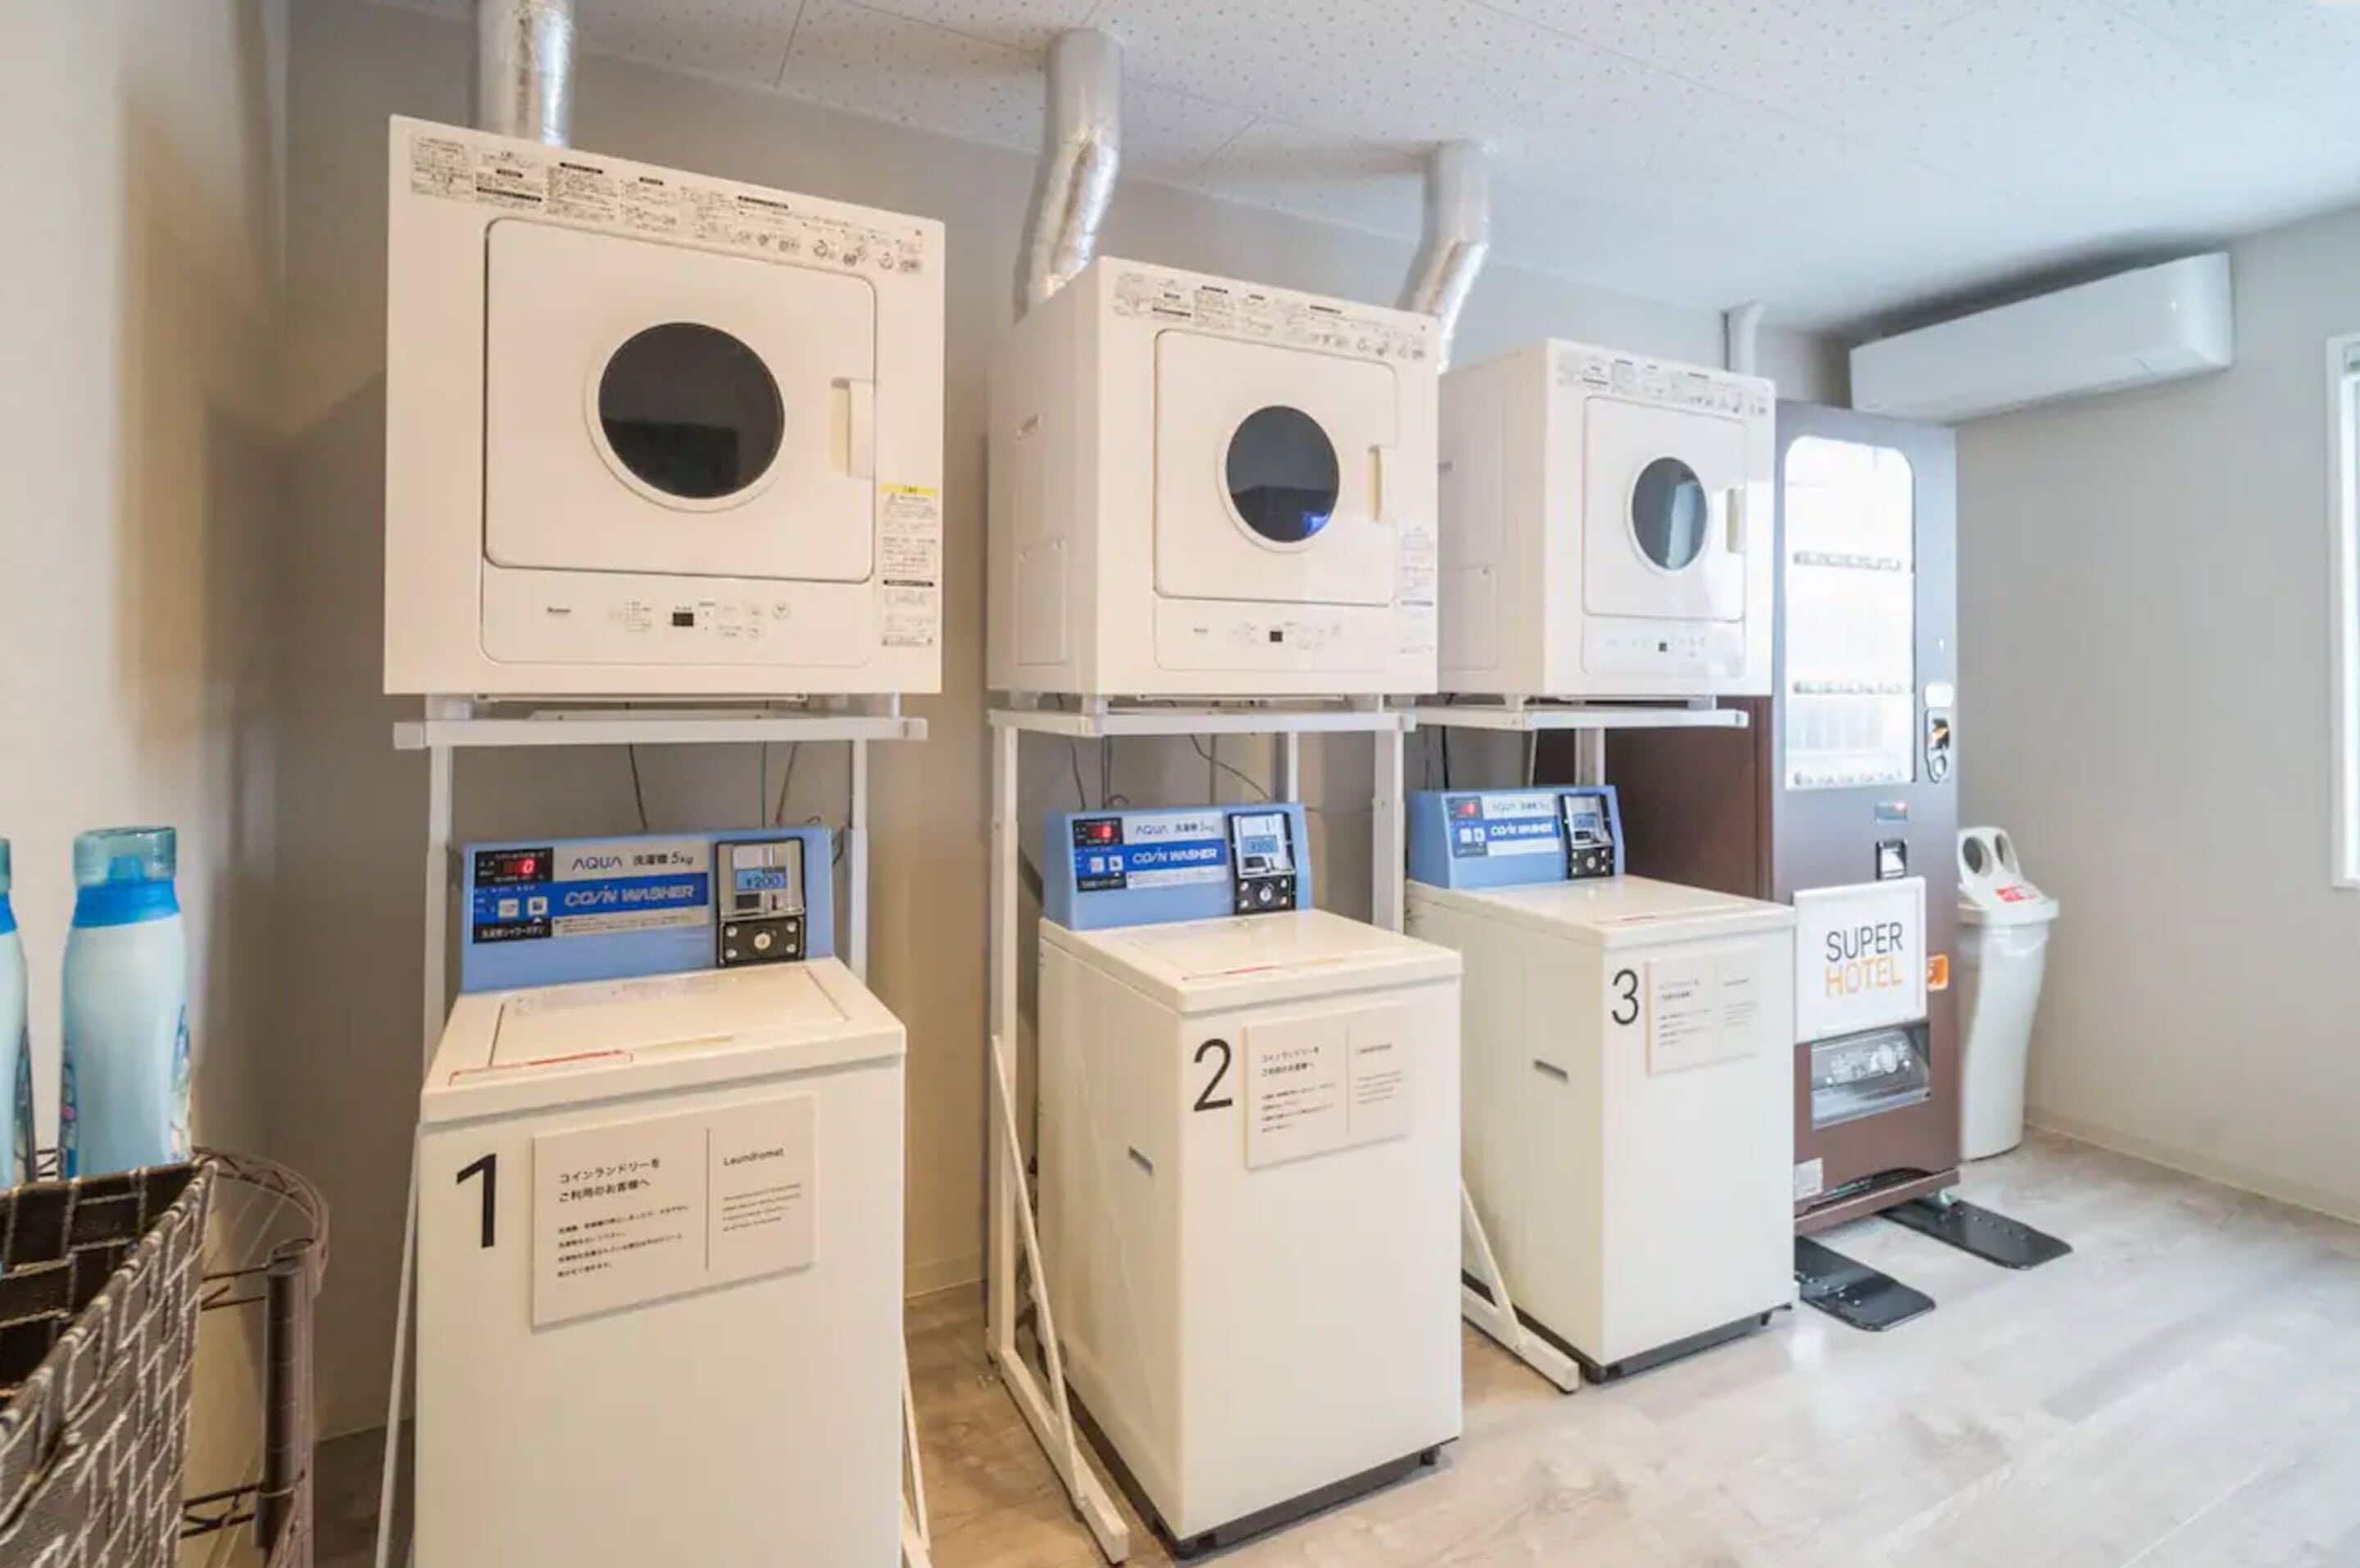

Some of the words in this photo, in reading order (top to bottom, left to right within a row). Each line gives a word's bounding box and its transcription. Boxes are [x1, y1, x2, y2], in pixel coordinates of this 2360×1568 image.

[572, 856, 623, 871] AQUA
[1170, 849, 1217, 862] WASHER
[622, 885, 695, 903] WASHER
[1826, 922, 1903, 963] SUPER
[1826, 957, 1904, 997] HOTEL
[1612, 969, 1639, 1026] 3
[1193, 1038, 1233, 1113] 2
[560, 1158, 660, 1184] コインランドリーを
[456, 1153, 497, 1249] 1
